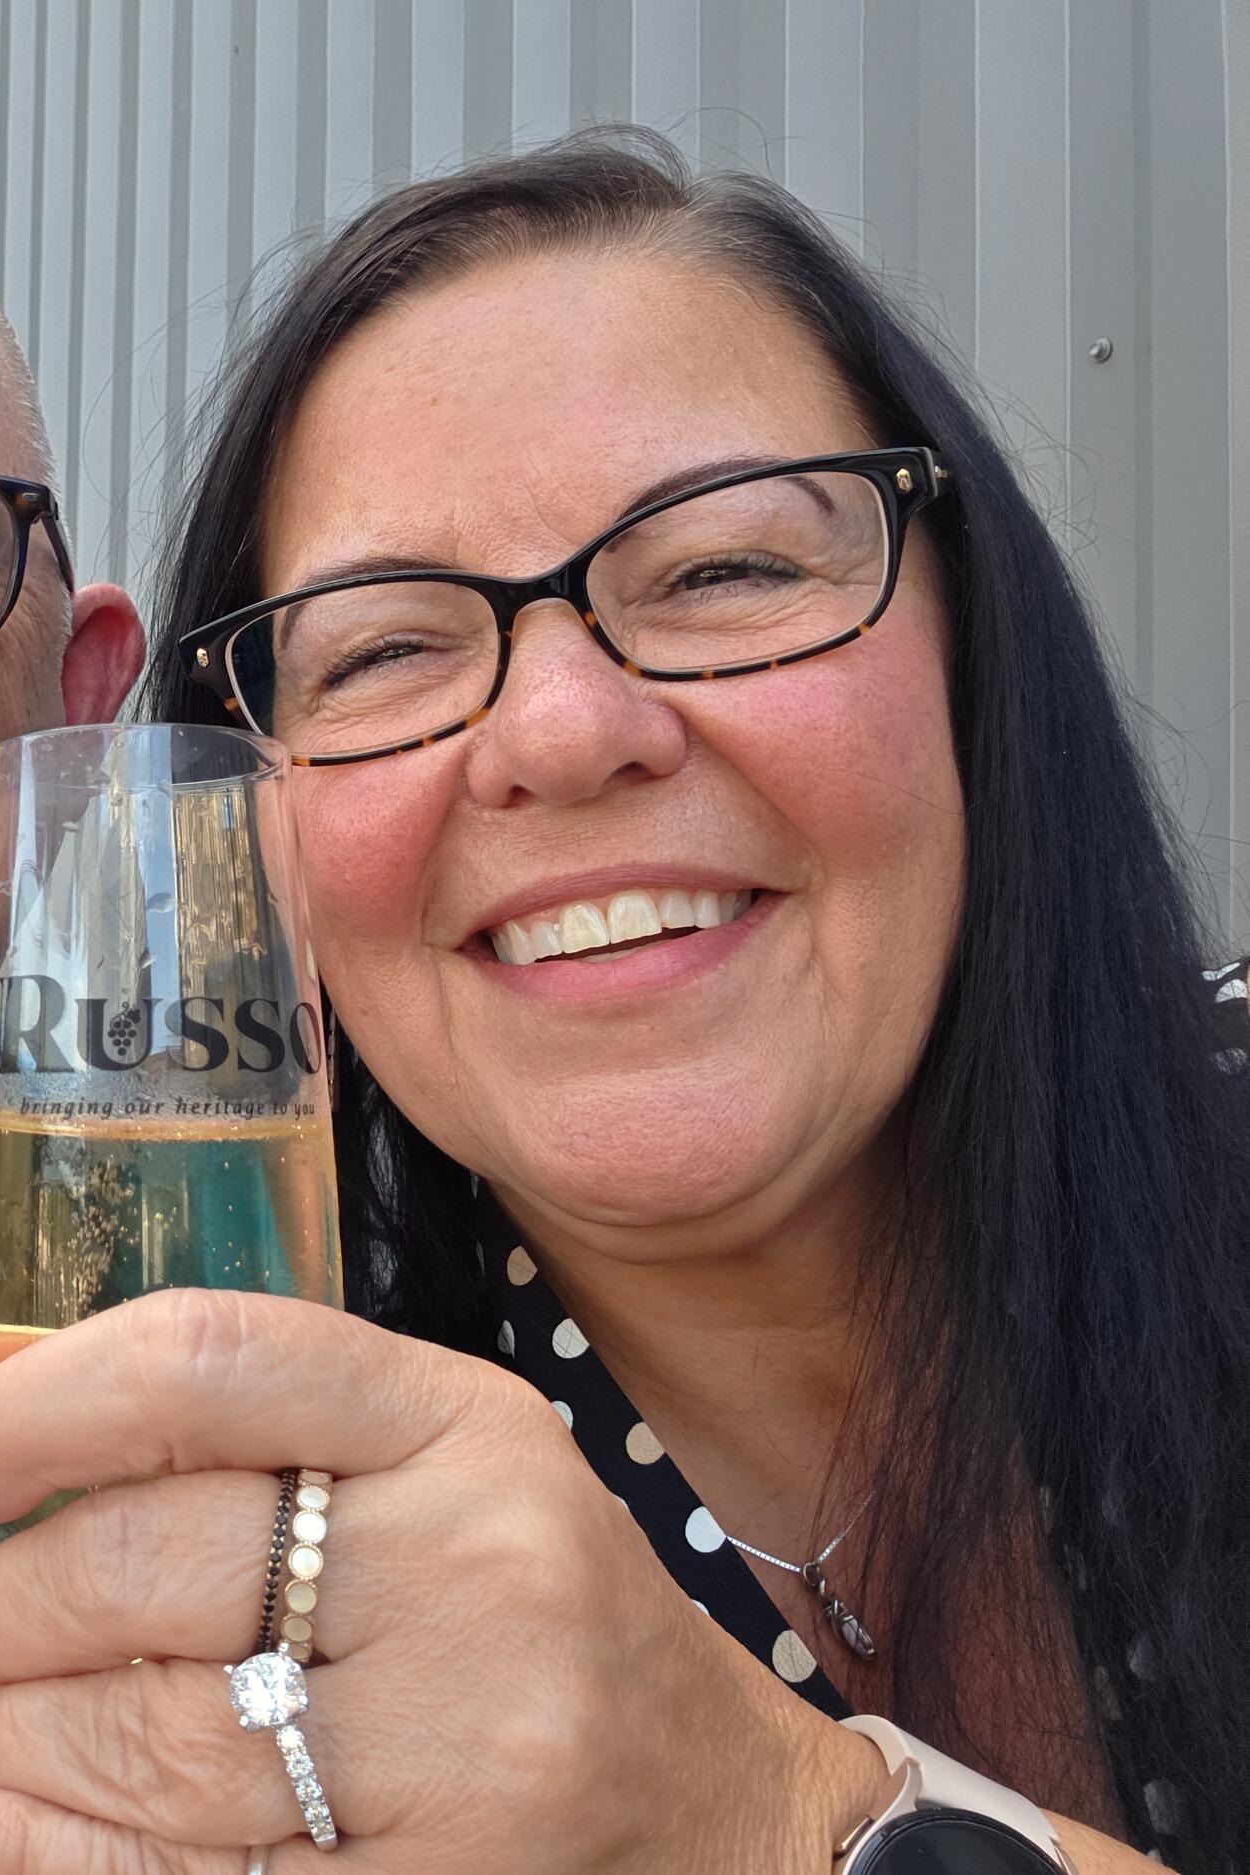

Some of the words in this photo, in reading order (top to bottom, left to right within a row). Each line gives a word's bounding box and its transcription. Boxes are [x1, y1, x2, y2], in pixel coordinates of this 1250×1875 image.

[20, 1097, 113, 1119] bringing
[124, 1100, 165, 1115] our
[175, 1097, 265, 1120] heritage
[273, 1101, 288, 1116] to
[294, 1102, 315, 1121] you
